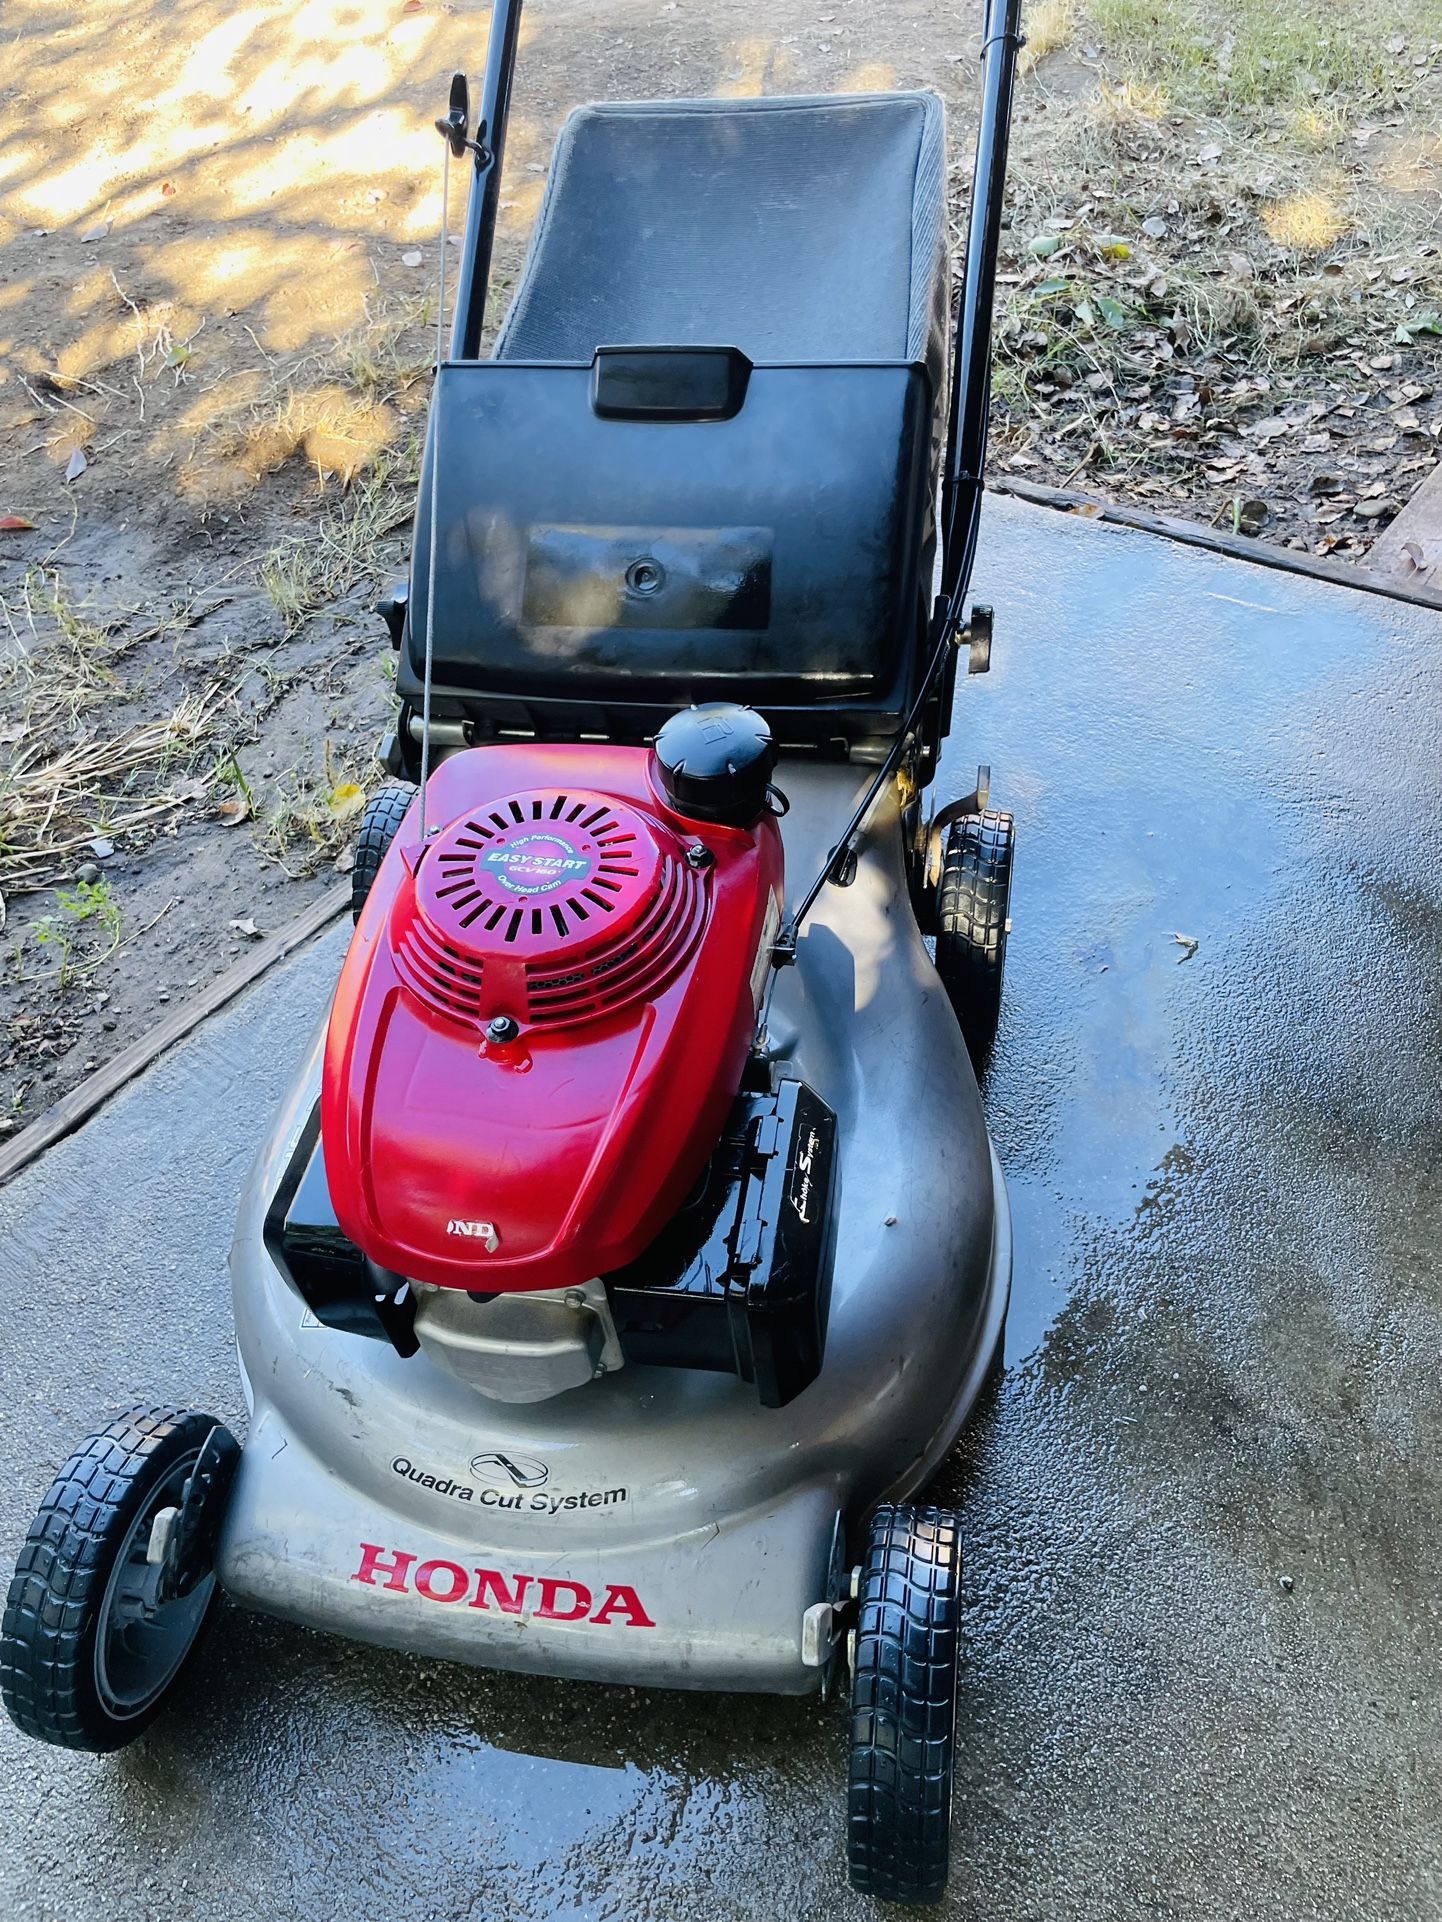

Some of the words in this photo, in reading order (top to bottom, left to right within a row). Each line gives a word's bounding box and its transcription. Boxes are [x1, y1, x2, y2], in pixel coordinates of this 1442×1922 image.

[510, 836, 529, 849] High
[530, 834, 574, 854] Performance
[487, 852, 531, 864] EASY
[532, 856, 587, 870] START
[508, 865, 557, 876] GCV160
[497, 874, 515, 890] Over
[513, 884, 540, 894] Head
[540, 879, 562, 892] Cam
[391, 1457, 473, 1502] Quadra
[479, 1488, 523, 1511] Cut
[529, 1486, 627, 1515] System
[351, 1542, 657, 1628] HONDA
